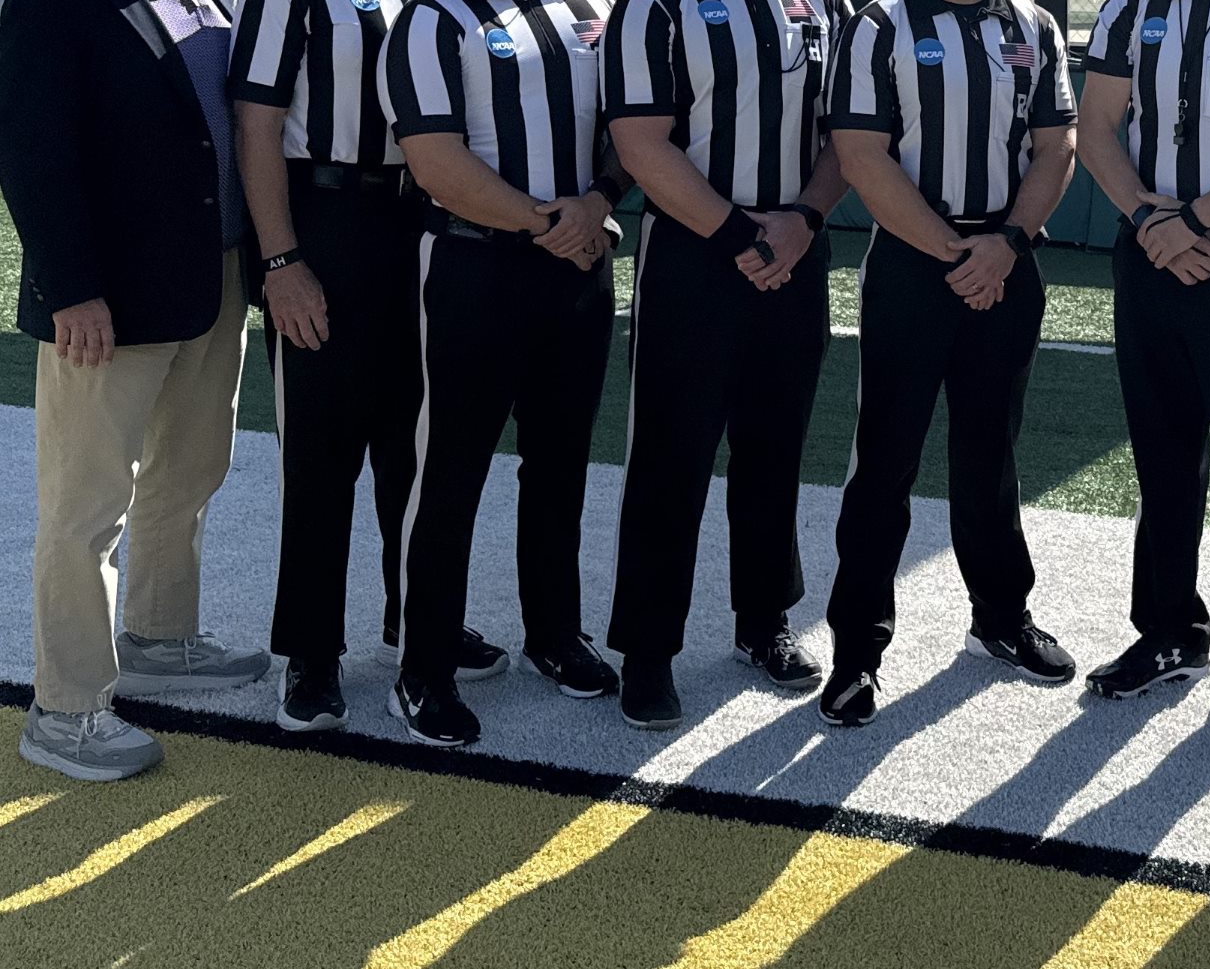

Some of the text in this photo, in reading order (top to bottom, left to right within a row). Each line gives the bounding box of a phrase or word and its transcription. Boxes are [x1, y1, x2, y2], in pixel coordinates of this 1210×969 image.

[704, 9, 728, 18] NCAA
[1143, 29, 1165, 37] NCAA
[492, 42, 516, 51] NCAA
[919, 50, 943, 59] NCAA
